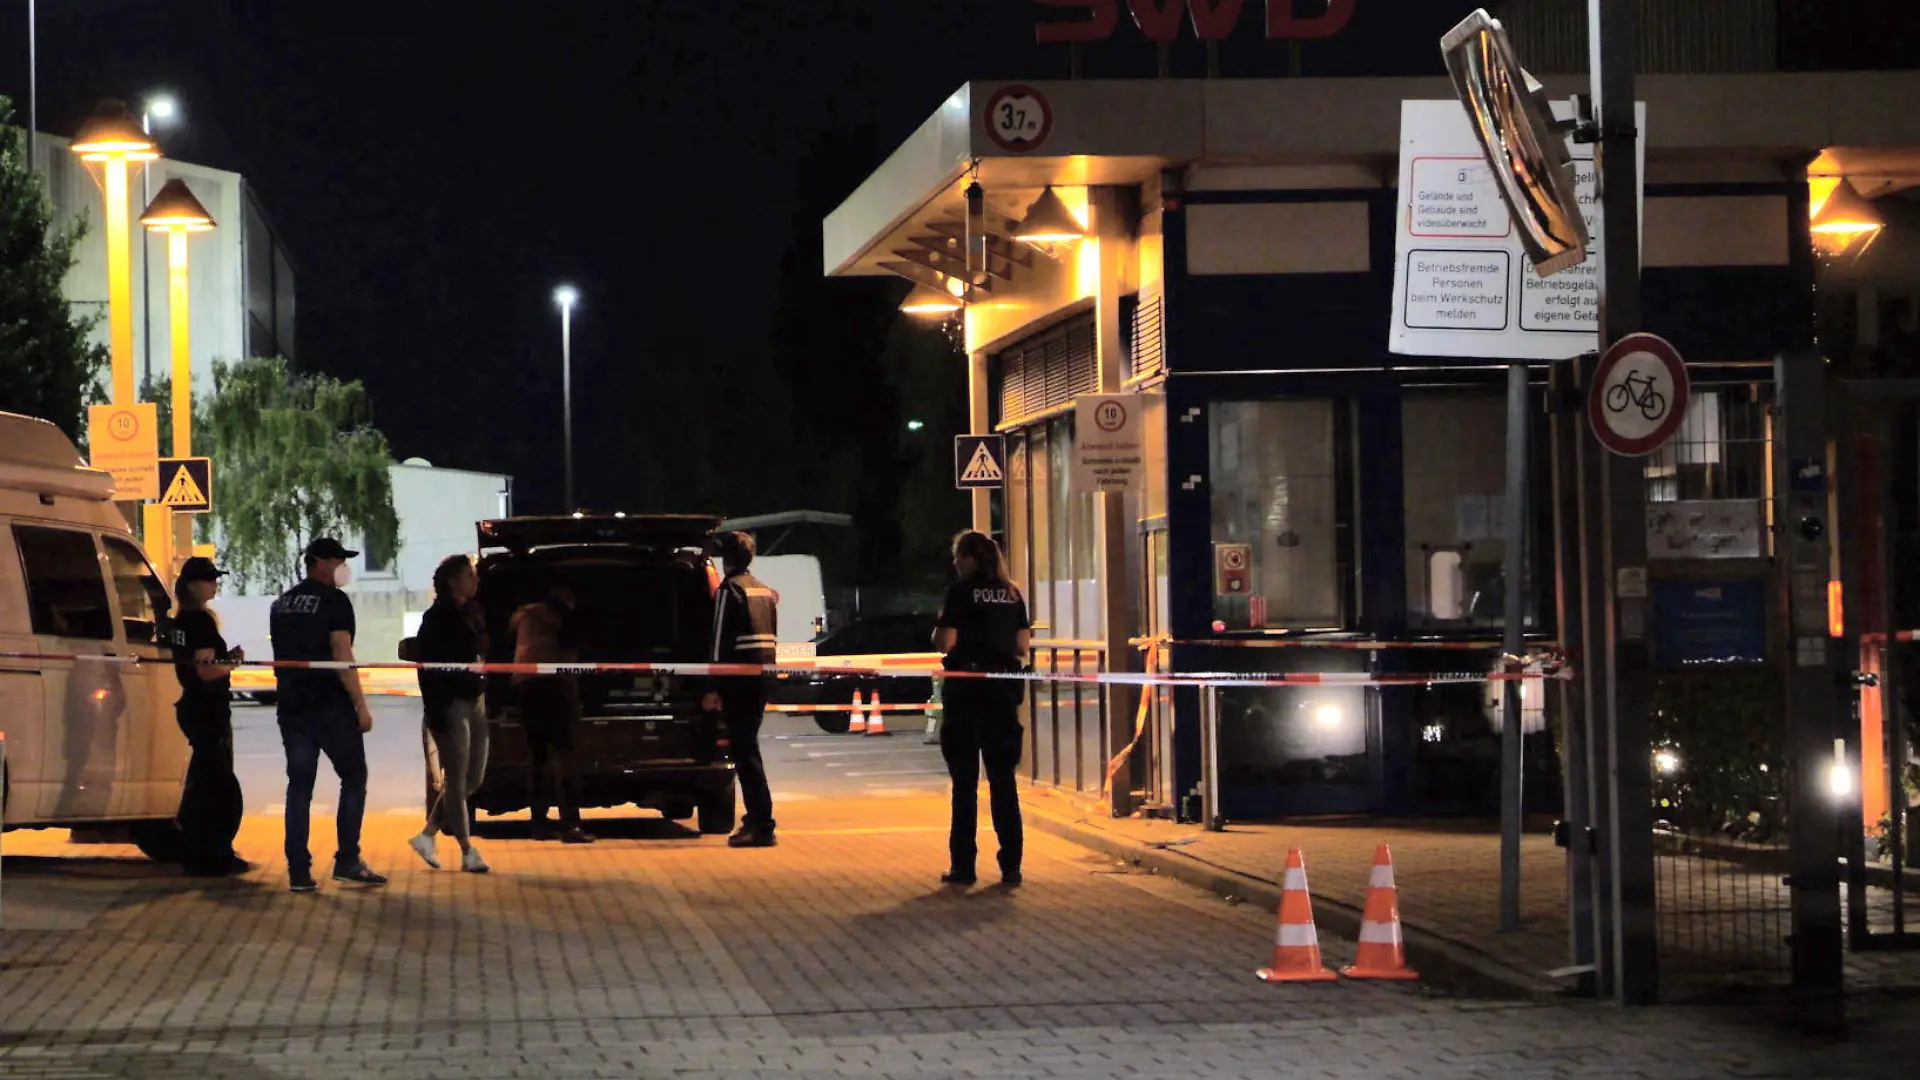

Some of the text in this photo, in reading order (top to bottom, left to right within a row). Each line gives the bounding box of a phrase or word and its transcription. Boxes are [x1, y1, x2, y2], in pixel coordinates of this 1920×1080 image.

[1456, 191, 1474, 200] und
[1459, 206, 1478, 214] sind
[1417, 262, 1500, 273] Betriebsfremde
[1432, 278, 1483, 288] Personen
[1411, 292, 1503, 305] beim Werkschutz
[1545, 295, 1597, 308] erfolgt au
[1436, 308, 1476, 319] melden
[1534, 310, 1598, 323] eigene Gefa
[117, 418, 130, 428] 10
[973, 588, 1015, 603] POLIZ
